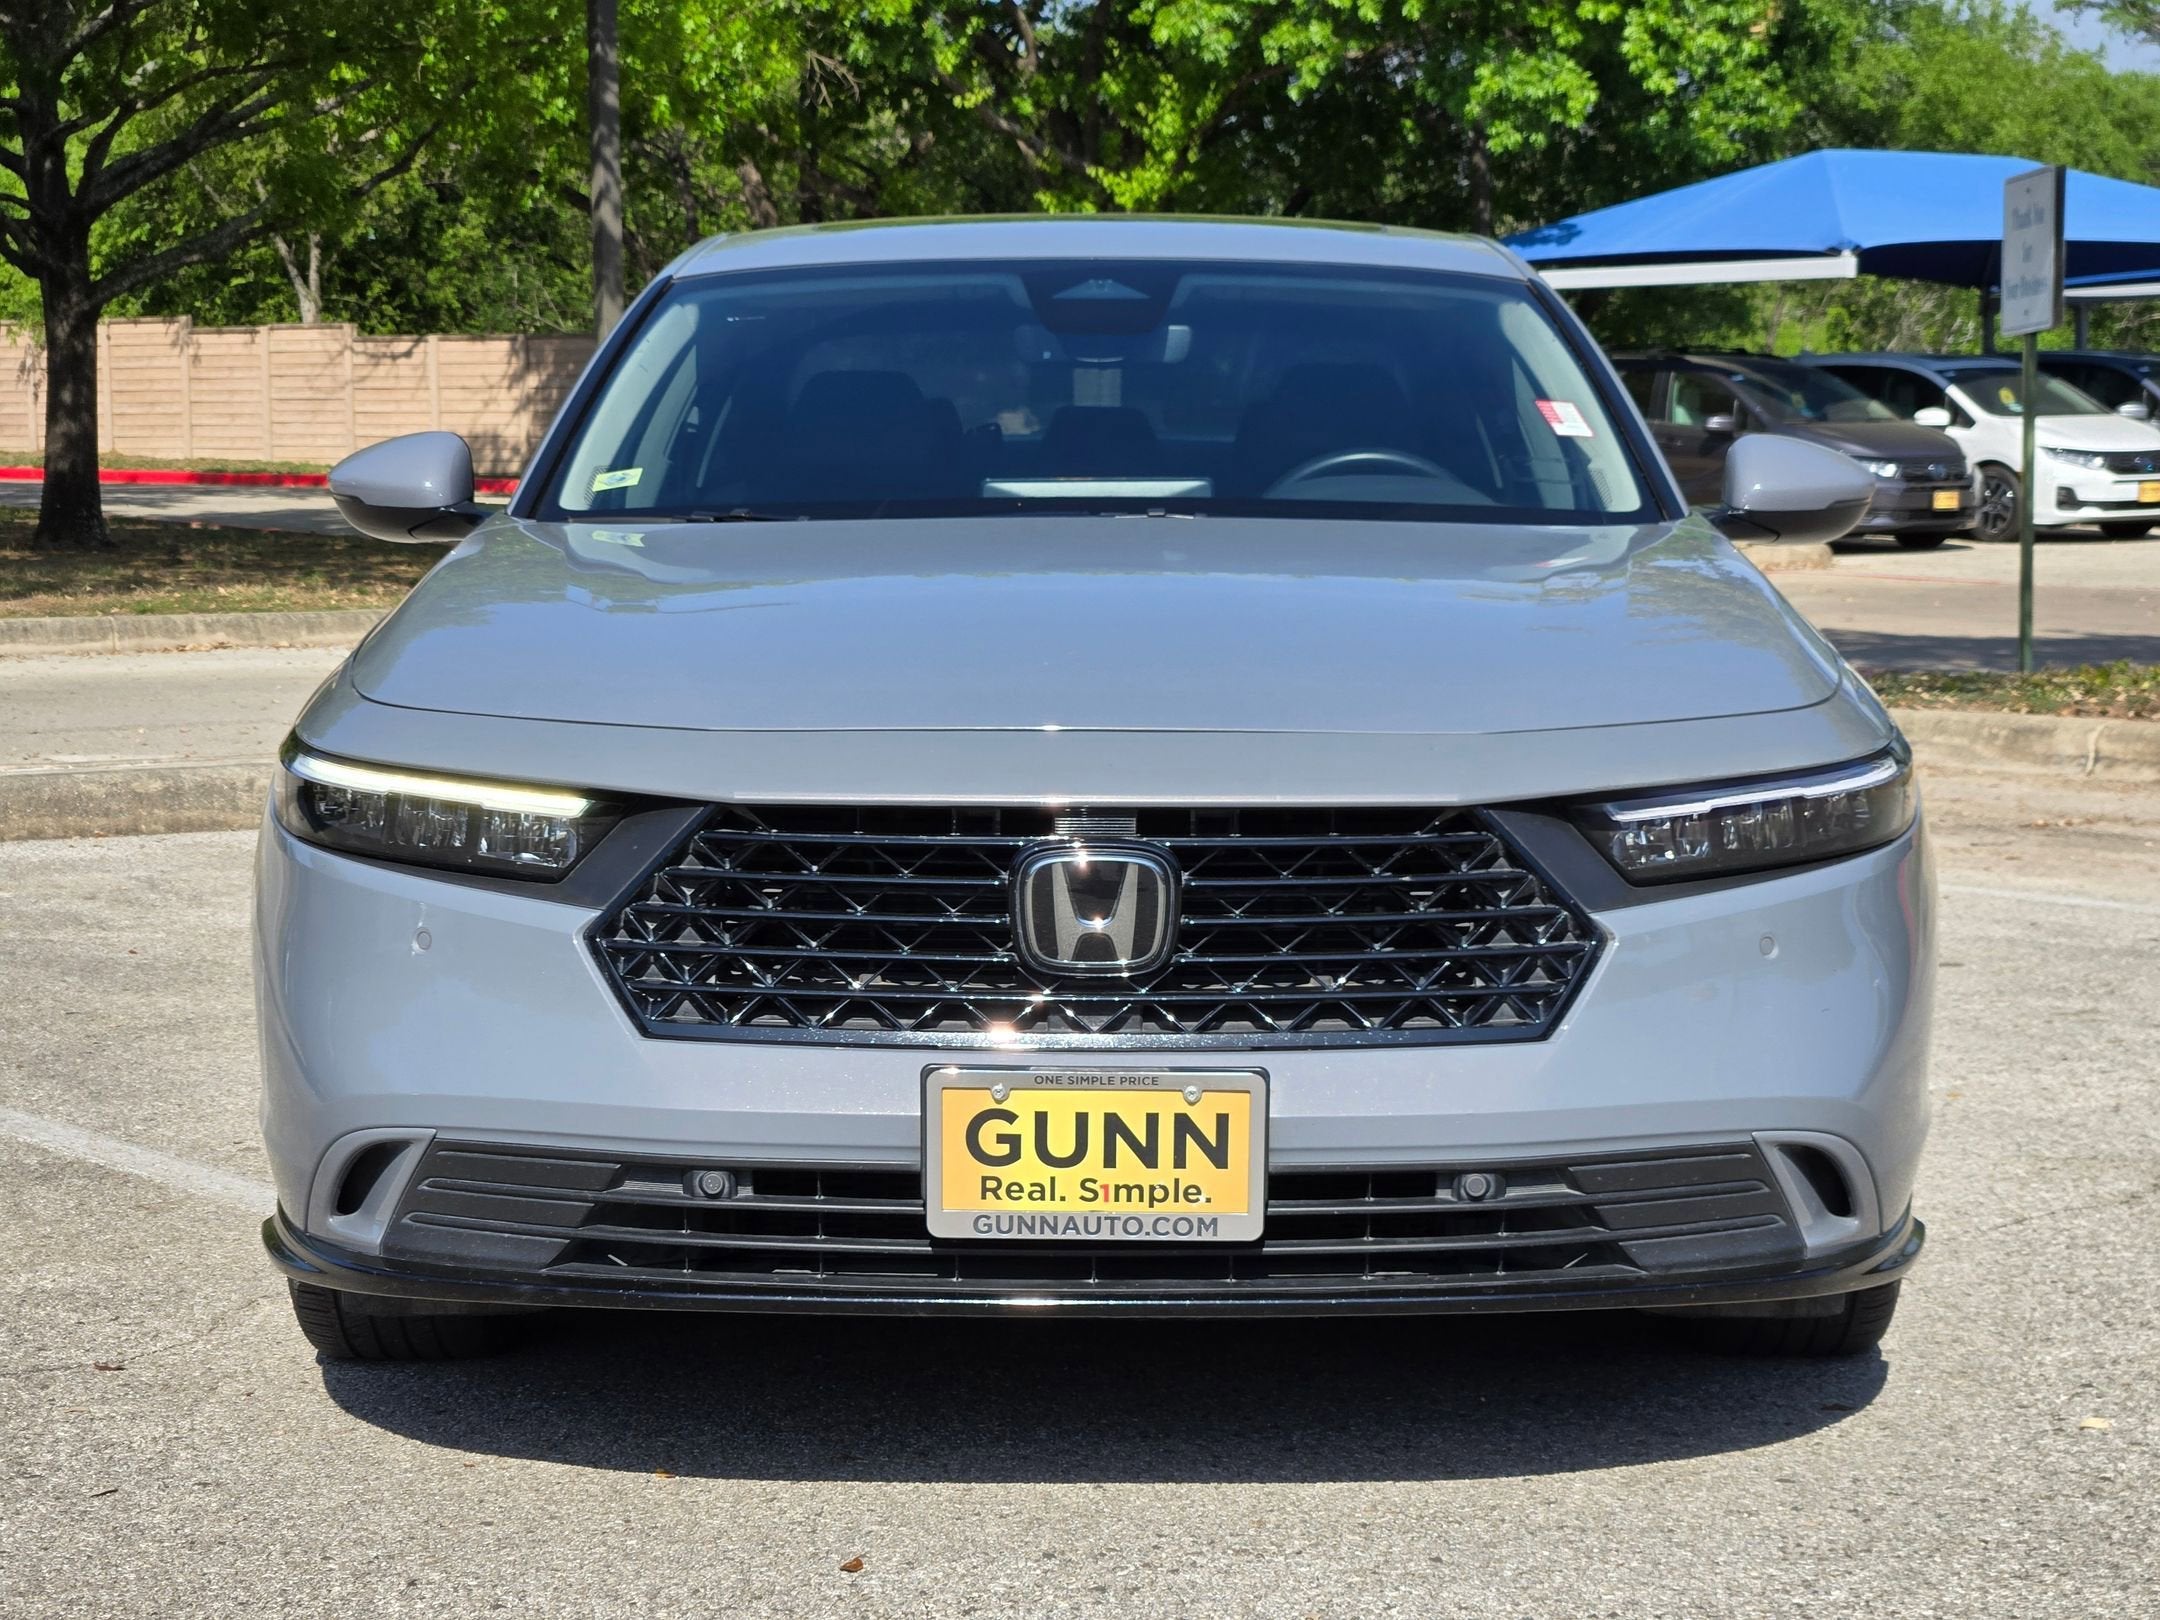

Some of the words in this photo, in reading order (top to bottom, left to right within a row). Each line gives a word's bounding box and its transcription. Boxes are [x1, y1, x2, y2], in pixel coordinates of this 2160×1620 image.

[1034, 1075, 1064, 1086] ONE
[1067, 1075, 1115, 1086] SIMPLE
[1119, 1076, 1159, 1086] PRICE
[965, 1108, 1230, 1169] GUNN
[981, 1175, 1066, 1202] Real.
[973, 1214, 1218, 1237] GUNNAUTO.COM
